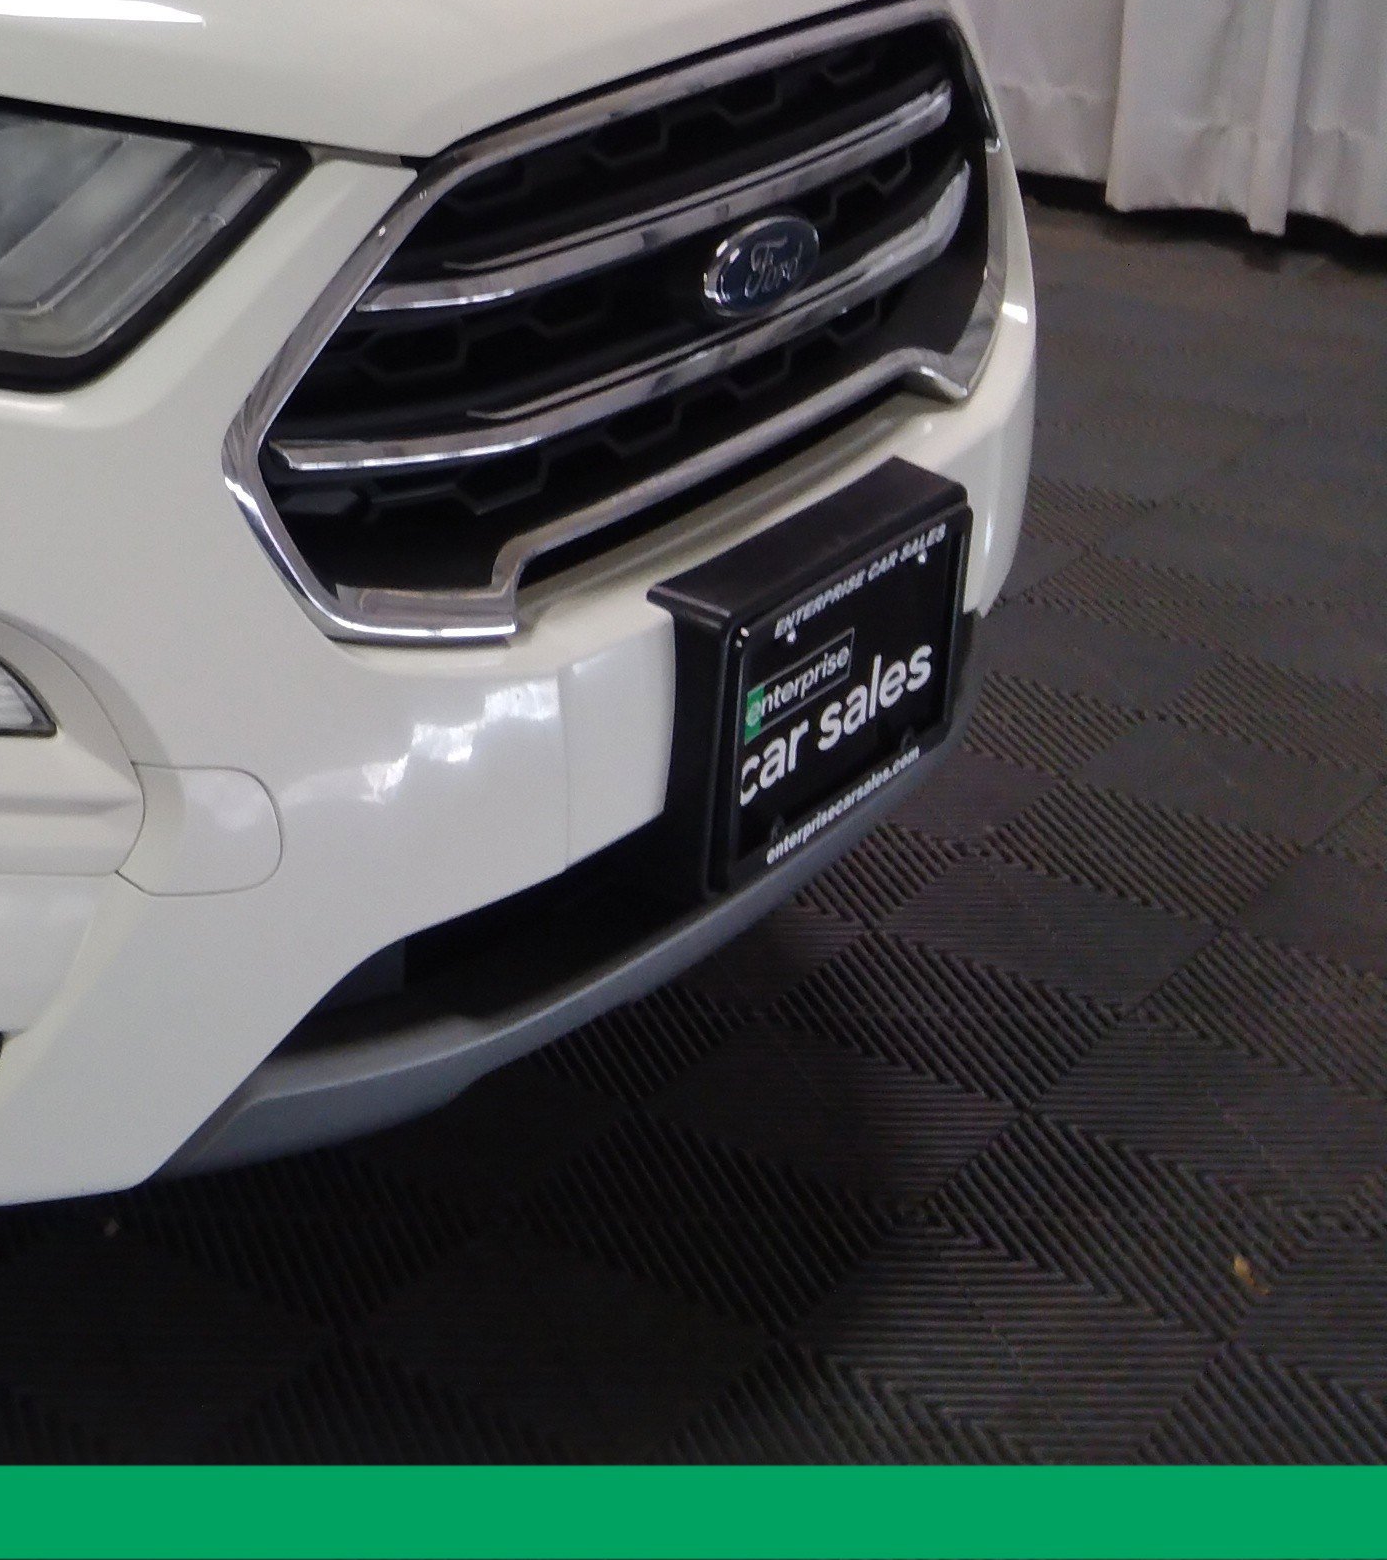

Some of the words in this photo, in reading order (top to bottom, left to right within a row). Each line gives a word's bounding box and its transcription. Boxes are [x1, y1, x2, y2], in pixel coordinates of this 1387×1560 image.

[744, 237, 803, 298] Ford
[774, 569, 866, 640] ENTERPRISE
[868, 550, 899, 582] CAR
[899, 522, 946, 562] SALES
[740, 719, 810, 807] car
[817, 644, 933, 751] sales
[746, 645, 850, 727] enterprise
[766, 745, 920, 865] enterprisecarsales.com
